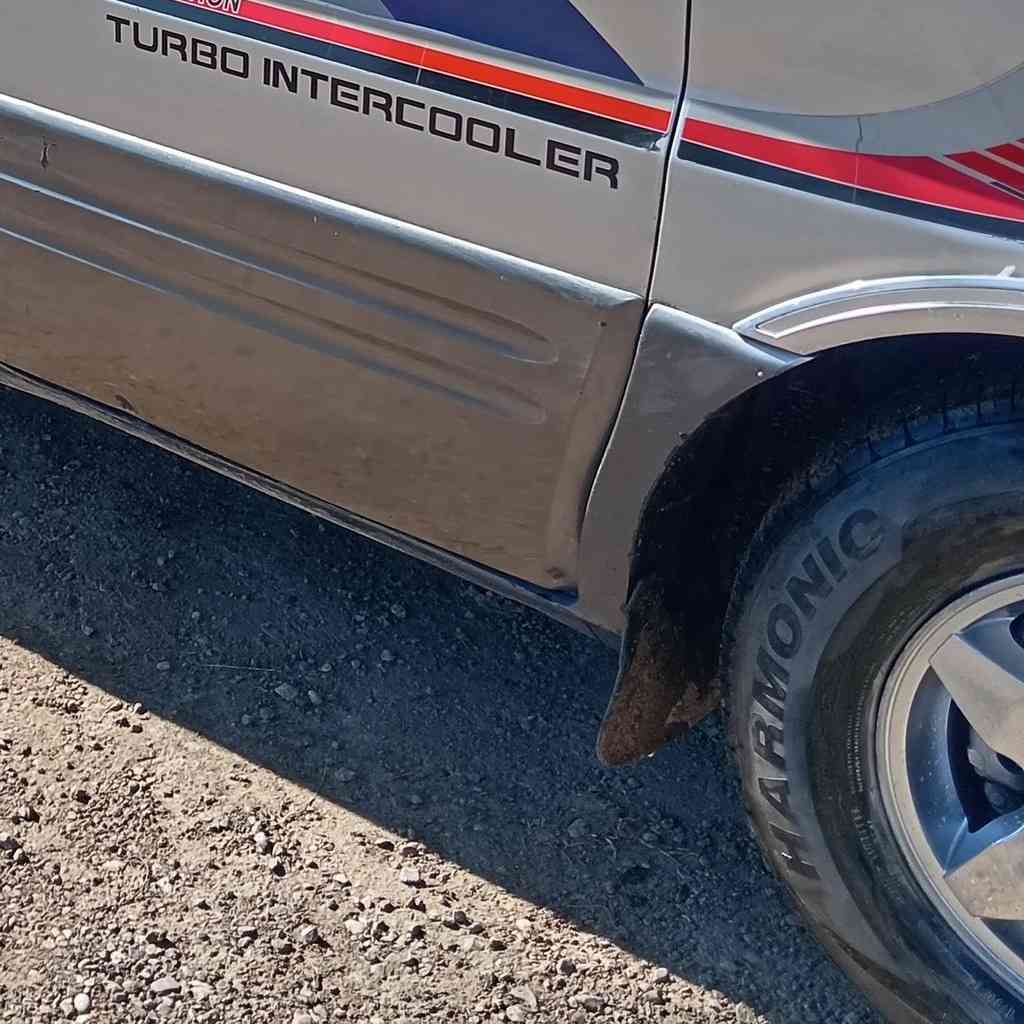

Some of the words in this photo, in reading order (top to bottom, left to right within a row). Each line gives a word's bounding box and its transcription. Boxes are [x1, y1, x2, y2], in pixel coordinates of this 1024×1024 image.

[106, 14, 249, 80] TURBO
[262, 57, 620, 190] INTERCOOLER
[750, 507, 888, 882] HARMONIC
